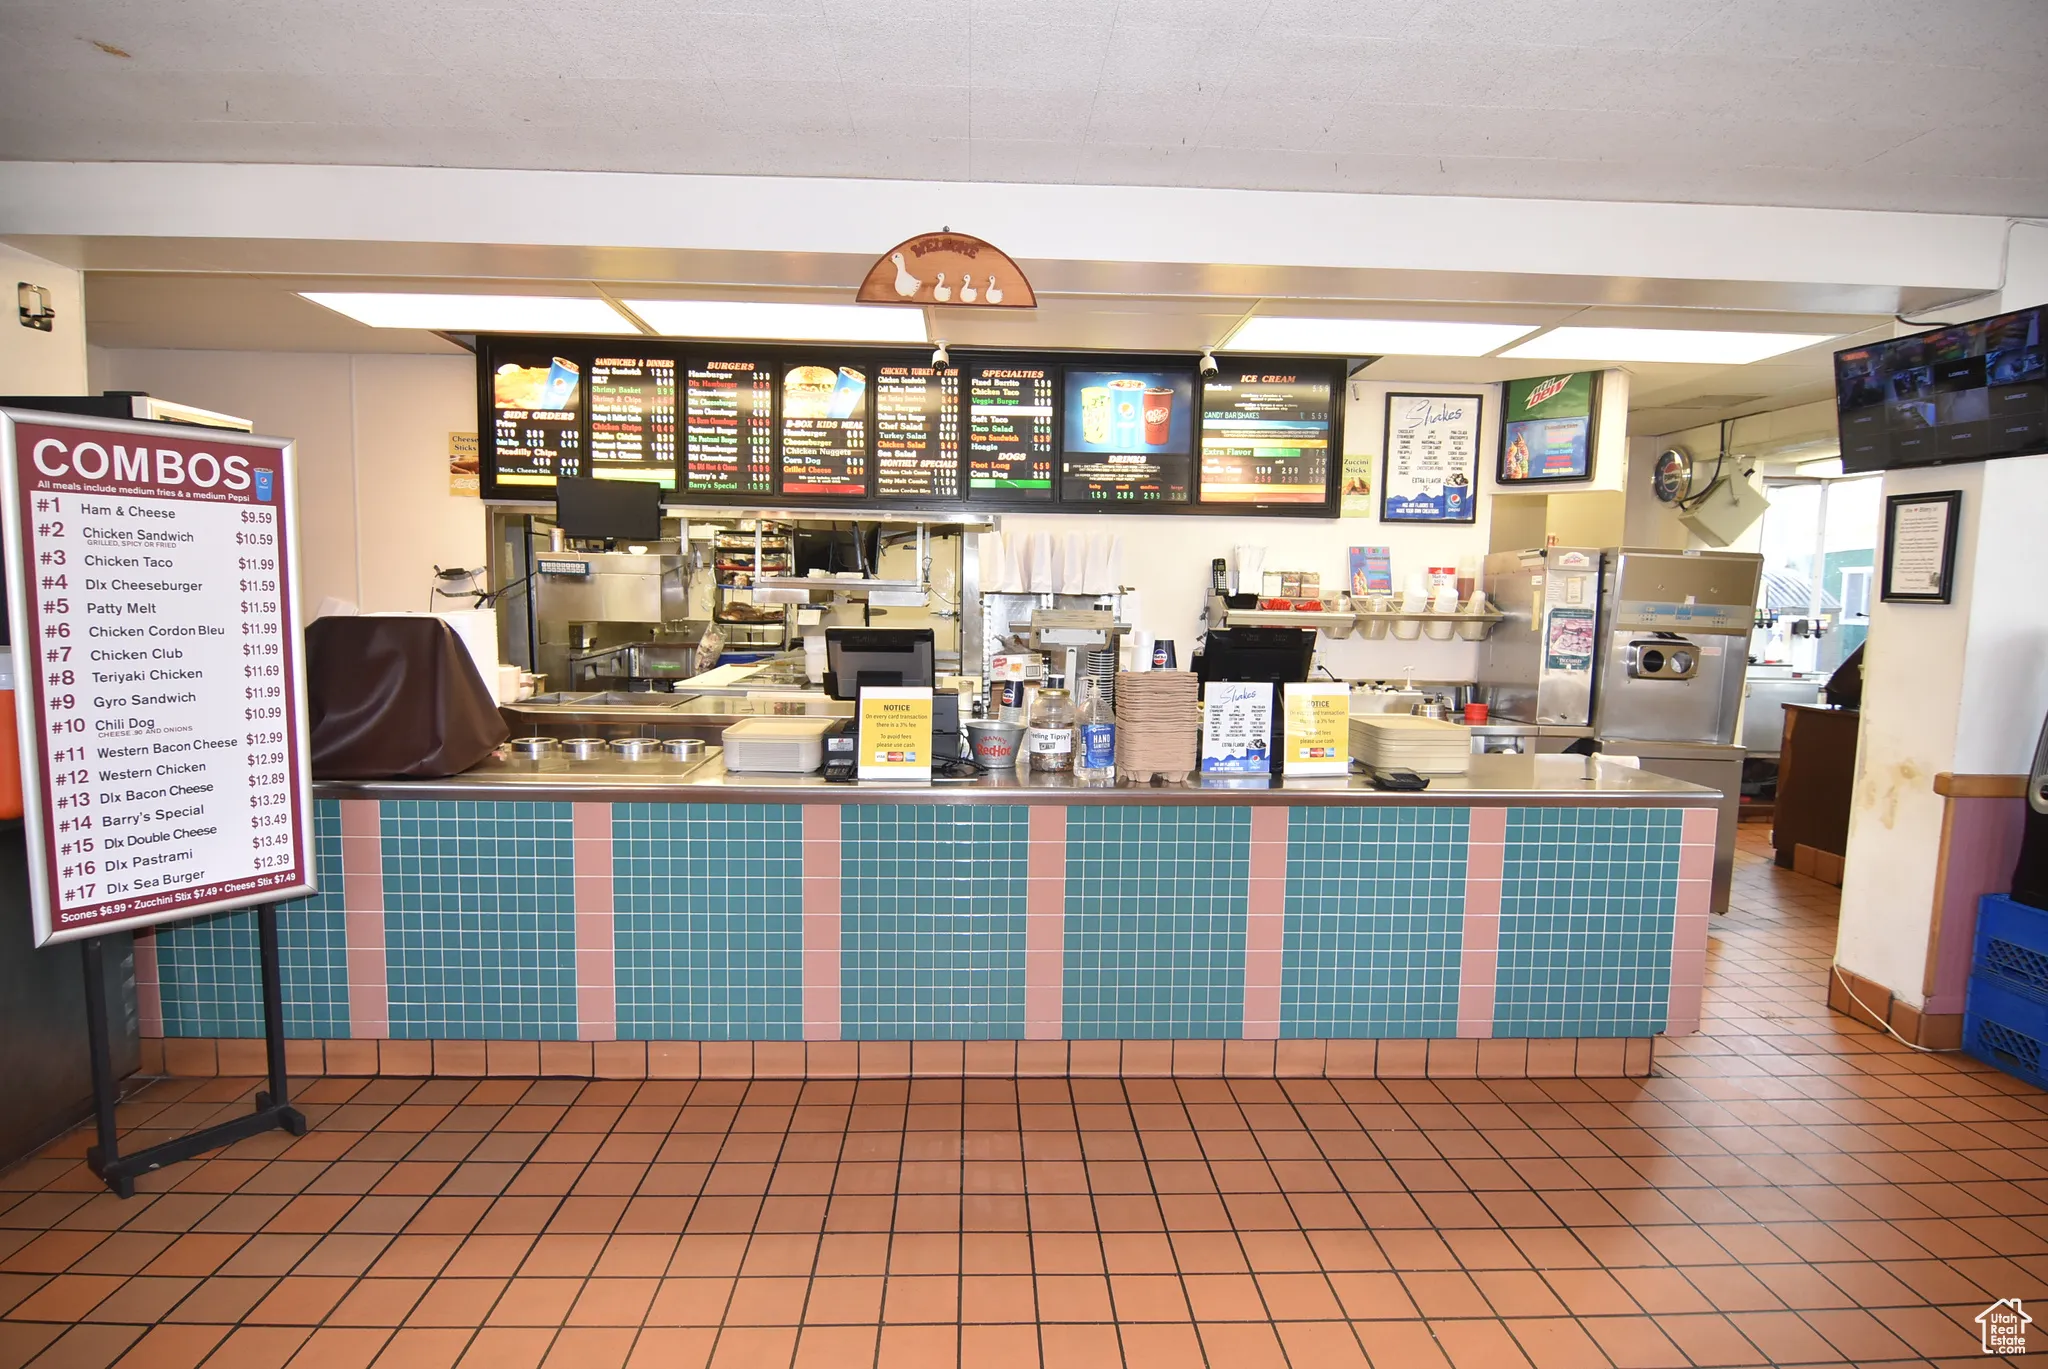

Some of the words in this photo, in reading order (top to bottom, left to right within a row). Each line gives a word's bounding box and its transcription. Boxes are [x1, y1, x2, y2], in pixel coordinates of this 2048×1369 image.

[595, 358, 636, 366] SANDWICHES
[638, 359, 643, 367] &
[707, 362, 754, 370] BURGERS
[982, 370, 1044, 378] SPECIALTIES
[592, 386, 616, 394] Shrimp
[503, 411, 528, 419] SIDE
[532, 412, 575, 420] ORDERS
[1406, 399, 1462, 428] Shakes
[816, 421, 838, 429] KIDS
[879, 432, 904, 440] Turkey
[820, 448, 851, 456] Nuggets
[1203, 448, 1224, 456] Extra
[1227, 448, 1251, 456] Flavor
[33, 438, 250, 490] COMBOS
[991, 462, 1010, 470] Long
[992, 471, 1008, 479] Dog
[37, 480, 50, 489] All
[53, 481, 81, 491] meals
[84, 483, 117, 493] include
[119, 485, 155, 497] medium
[157, 488, 176, 497] fries
[193, 491, 225, 500] medium
[37, 498, 60, 513] #1
[81, 503, 111, 516] Ham
[116, 506, 125, 516] &
[129, 506, 176, 519] Cheese
[241, 510, 272, 524] $9.59
[38, 521, 64, 538] #2
[83, 527, 133, 540] Chicken
[137, 529, 194, 542] Sandwich
[236, 533, 273, 545] $10.59
[40, 550, 66, 565] #3
[85, 555, 139, 568] Chicken
[144, 557, 173, 568] Taco
[238, 557, 274, 570] $11.99
[42, 574, 68, 590] #4
[86, 579, 107, 591] Dlx
[111, 578, 202, 592] Cheeseburger
[240, 580, 275, 592] $11.59
[43, 598, 69, 613] #5
[87, 603, 122, 615] Patty
[127, 603, 156, 613] Melt
[240, 602, 276, 614] $11.59
[45, 623, 70, 638] #6
[89, 626, 144, 637] Chicken
[149, 626, 195, 636] Cordon
[199, 625, 225, 635] Bleu
[242, 623, 277, 635] $11.99
[47, 647, 72, 662] #7
[90, 650, 147, 661] Chicken
[152, 649, 183, 659] Club
[243, 644, 278, 656] $11.99
[49, 670, 75, 686] #8
[93, 672, 145, 684] Teriyaki
[150, 669, 203, 680] Chicken
[244, 665, 279, 678] $11.69
[1220, 685, 1256, 704] Shakes
[52, 718, 85, 734] #10
[95, 719, 124, 731] Chili
[129, 718, 154, 731] Dog
[245, 707, 281, 720] $10.99
[98, 730, 131, 738] CHEESE
[1050, 733, 1070, 741] Tipsy?
[1094, 735, 1110, 743] HAND
[976, 744, 1012, 756] RedHot
[56, 770, 89, 785] #12
[100, 768, 152, 781] Western
[156, 762, 206, 774] Chicken
[247, 753, 284, 766] $12.99
[59, 815, 92, 832] #14
[103, 812, 150, 827] Barry's
[155, 804, 204, 820] Special
[250, 794, 286, 808] $13.29
[65, 884, 97, 901] #17
[107, 881, 128, 895] Dlx
[134, 878, 159, 890] Sea
[163, 870, 205, 887] Burger
[253, 854, 289, 869] $12.39
[61, 909, 97, 923] Scones
[100, 903, 126, 917] $6.99
[134, 894, 172, 909] Zucchini
[175, 891, 191, 903] Stix
[194, 887, 217, 899] $7.49
[225, 881, 255, 894] Cheese
[258, 878, 272, 887] Stix
[274, 872, 296, 884] $7.49
